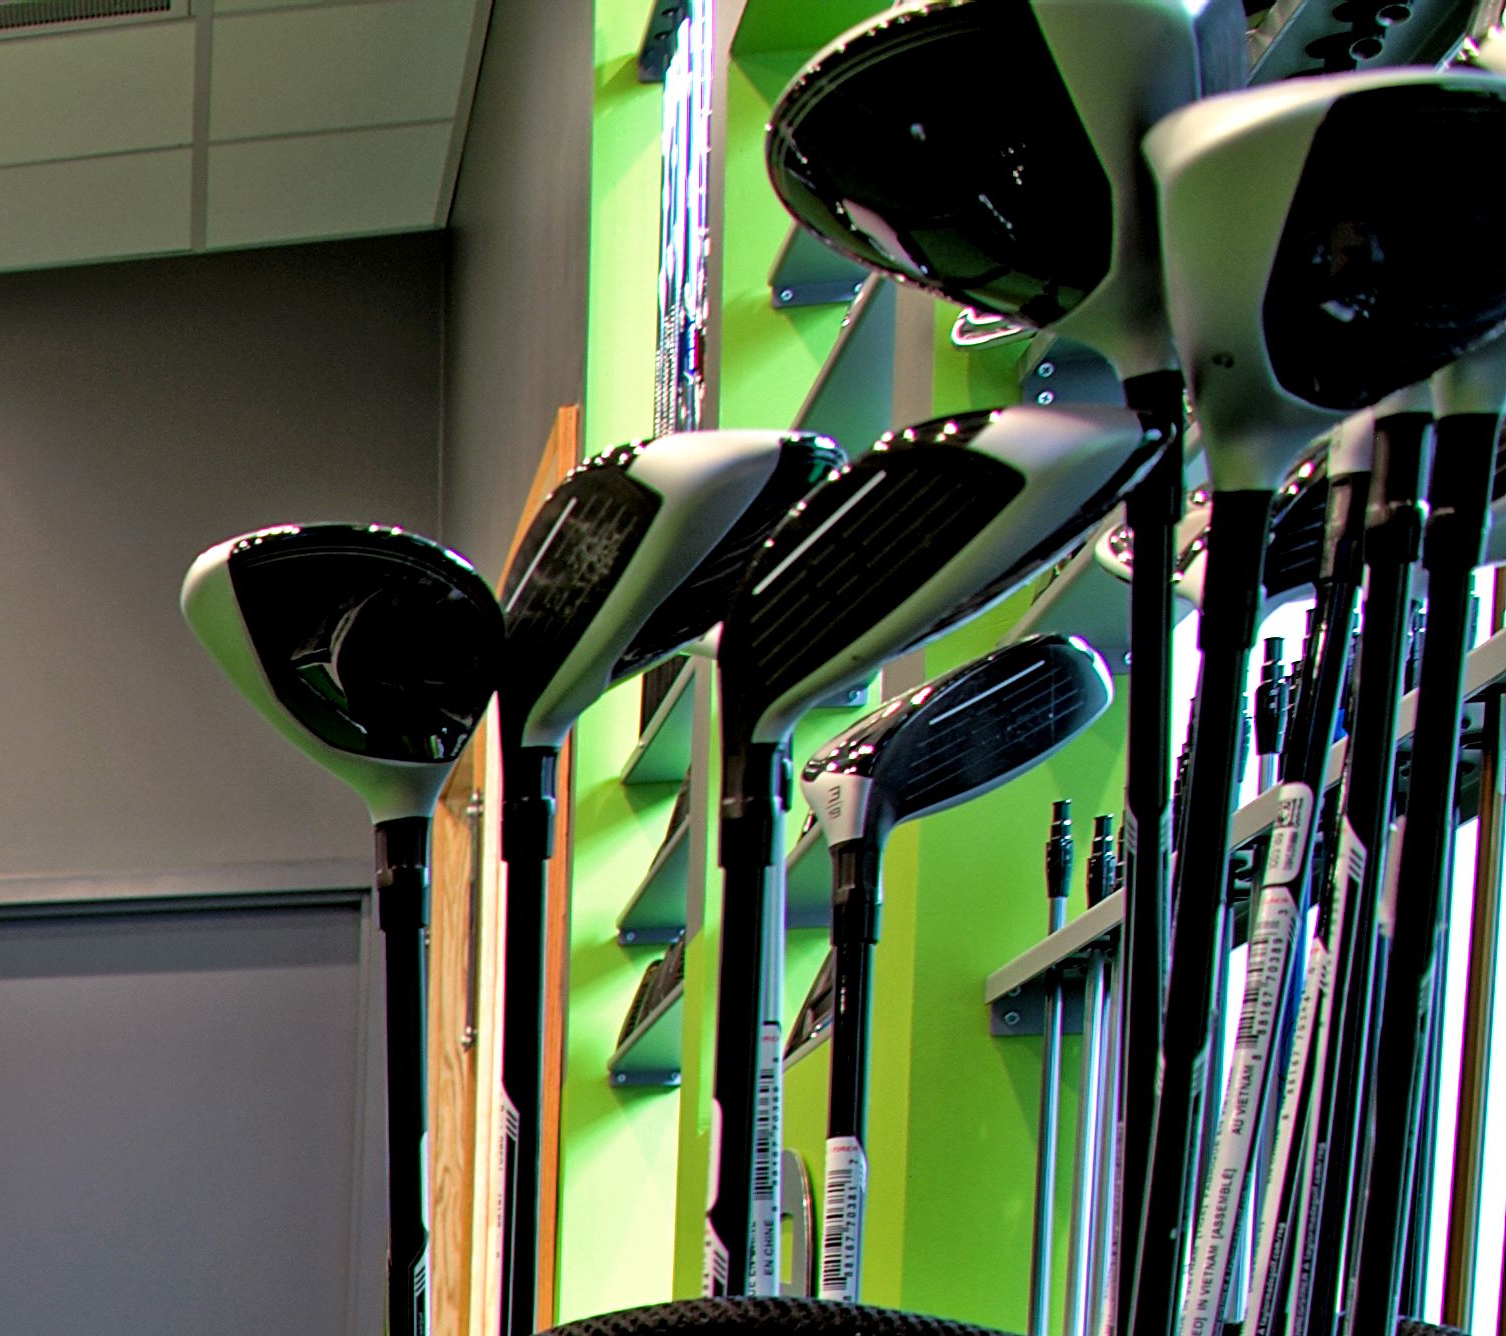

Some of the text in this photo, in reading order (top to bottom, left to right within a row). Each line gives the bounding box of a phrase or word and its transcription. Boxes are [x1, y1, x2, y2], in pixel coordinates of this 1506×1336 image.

[1234, 1064, 1255, 1115] VIETNAM
[1231, 1118, 1243, 1135] AU
[764, 1259, 772, 1275] EN
[1198, 1244, 1219, 1296] VIETNAM
[1197, 1298, 1208, 1311] IN
